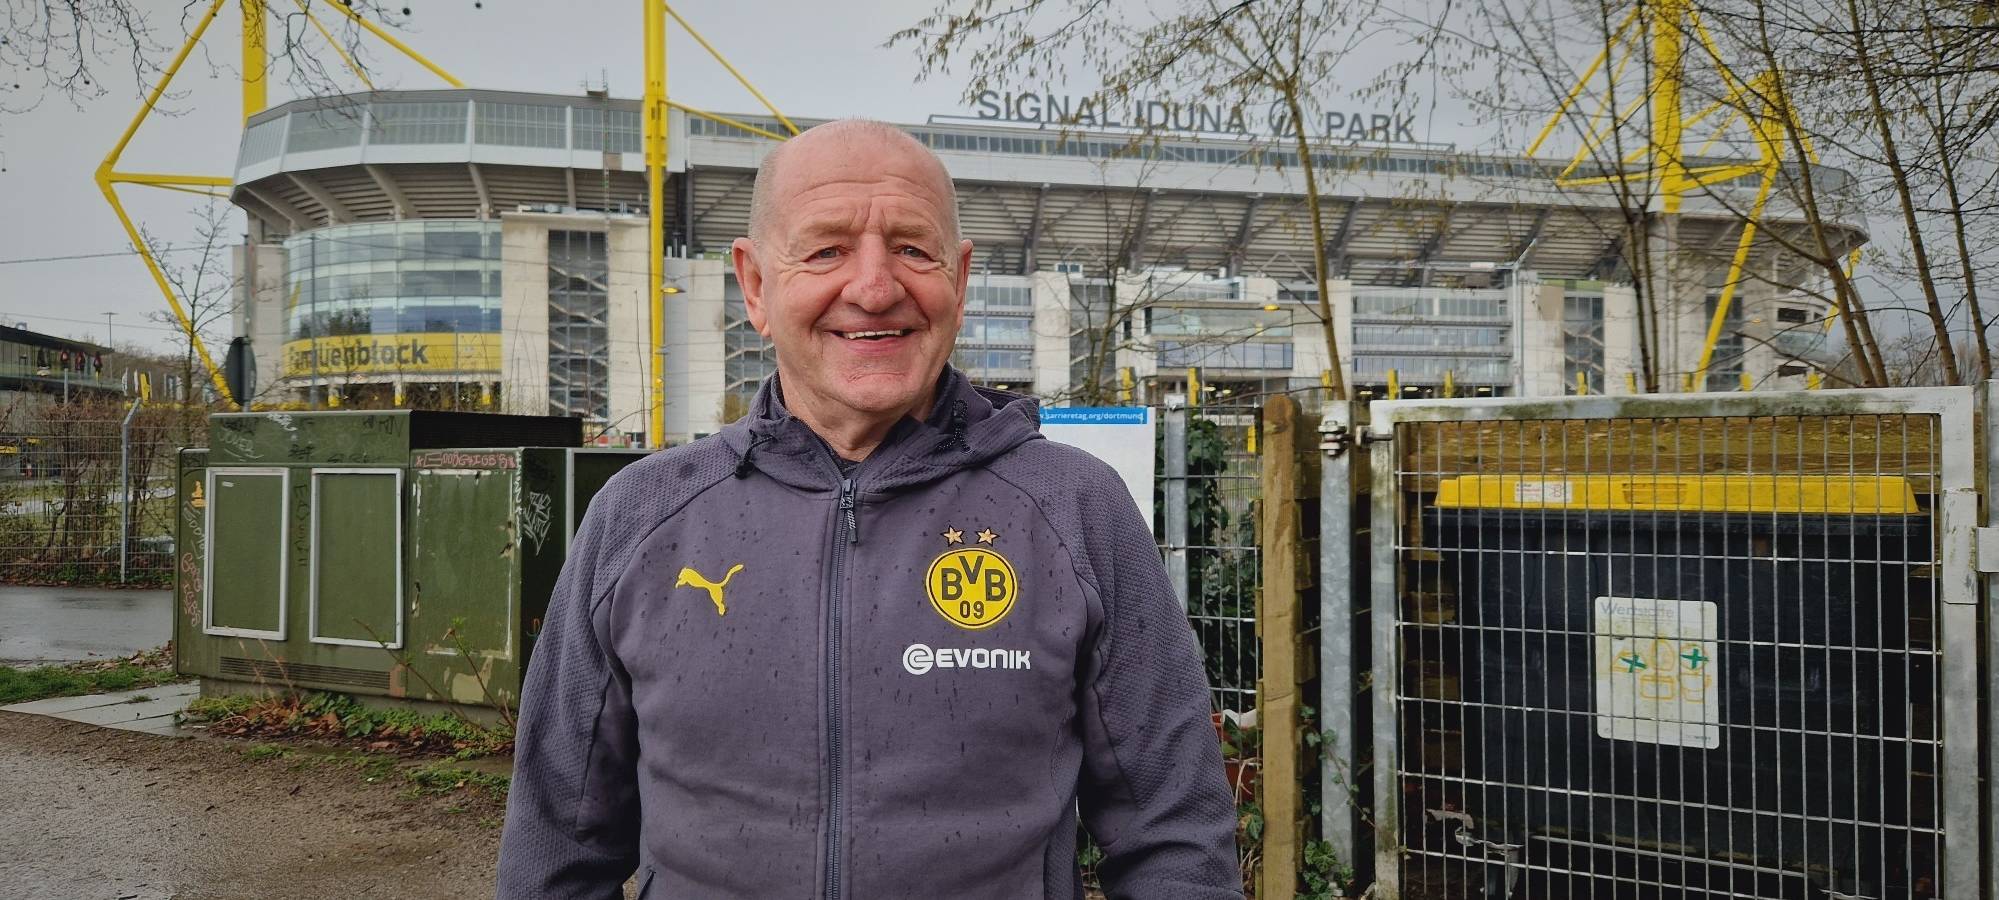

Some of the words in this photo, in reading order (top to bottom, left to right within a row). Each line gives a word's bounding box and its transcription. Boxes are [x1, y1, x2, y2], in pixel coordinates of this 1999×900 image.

[977, 90, 1121, 127] SIGNAL
[1136, 99, 1249, 135] IDUNA
[1325, 111, 1416, 143] PARK
[289, 338, 429, 369] Famlienblock
[940, 555, 1007, 602] BVB
[959, 600, 985, 619] 09
[935, 648, 1031, 670] EVONIK
